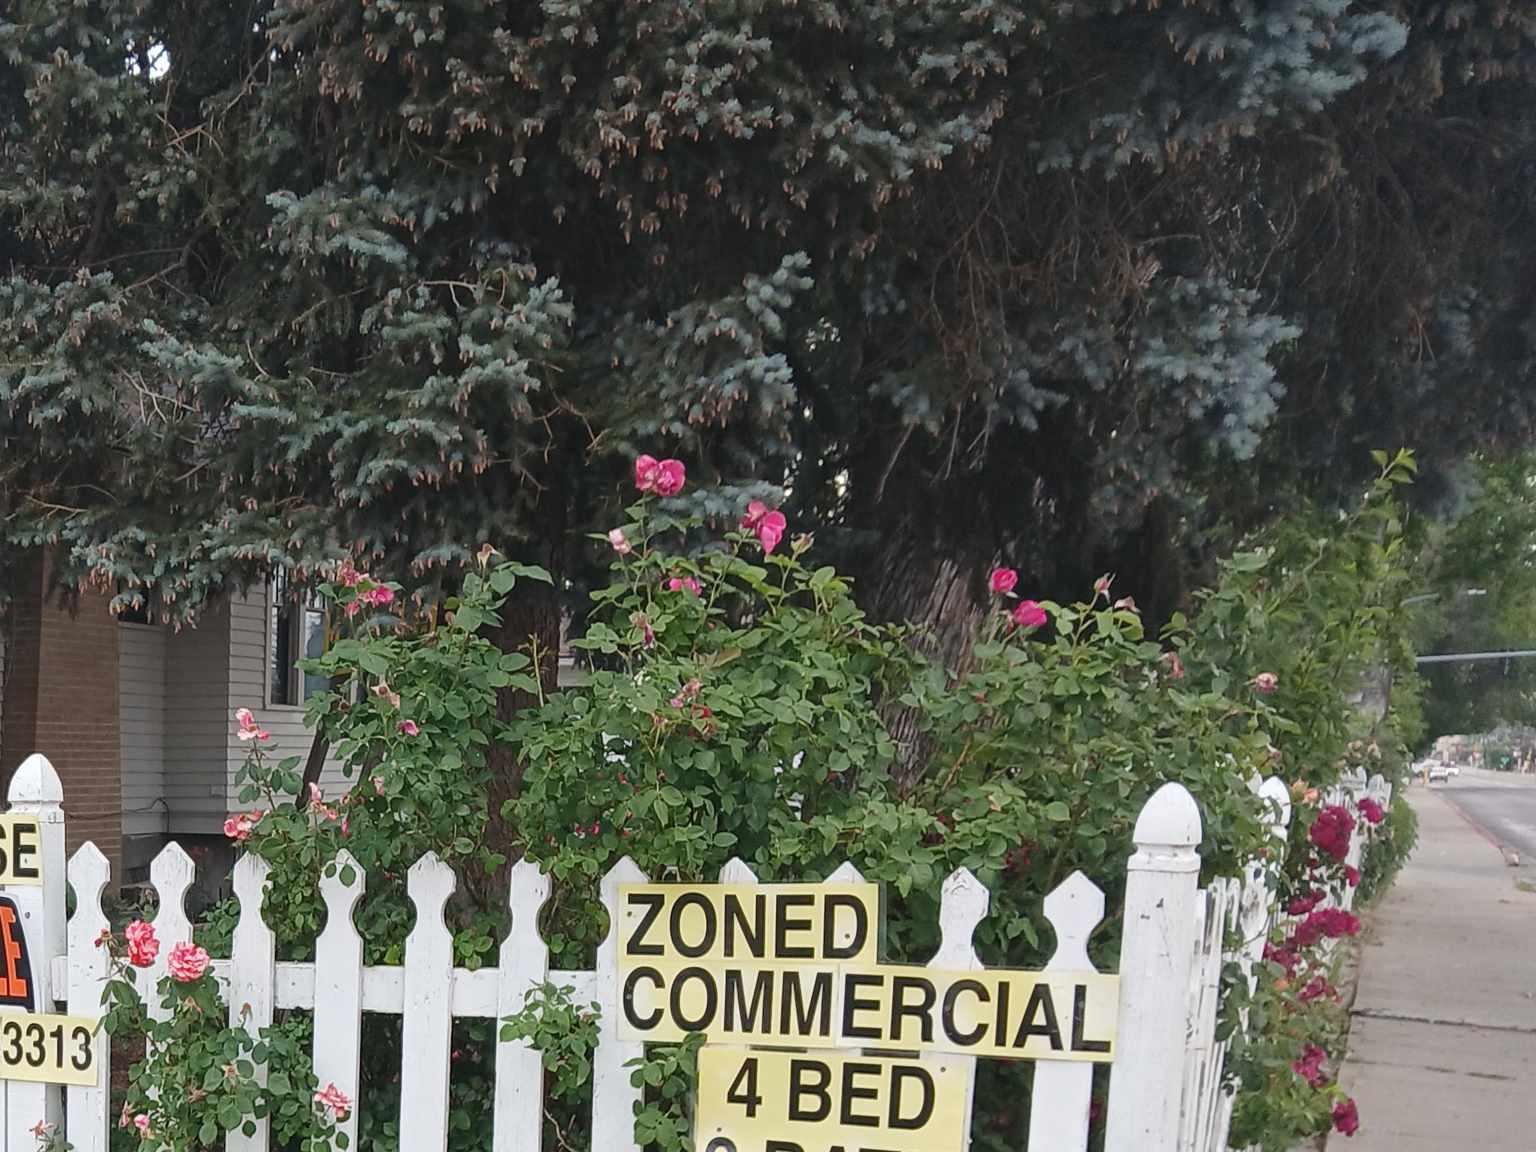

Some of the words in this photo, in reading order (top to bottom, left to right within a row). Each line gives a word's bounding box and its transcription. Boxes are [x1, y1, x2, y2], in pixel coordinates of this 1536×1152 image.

[625, 891, 868, 961] ZONED
[622, 965, 1112, 1054] COMMERCIAL
[726, 1057, 763, 1119] 4
[787, 1058, 936, 1131] BED
